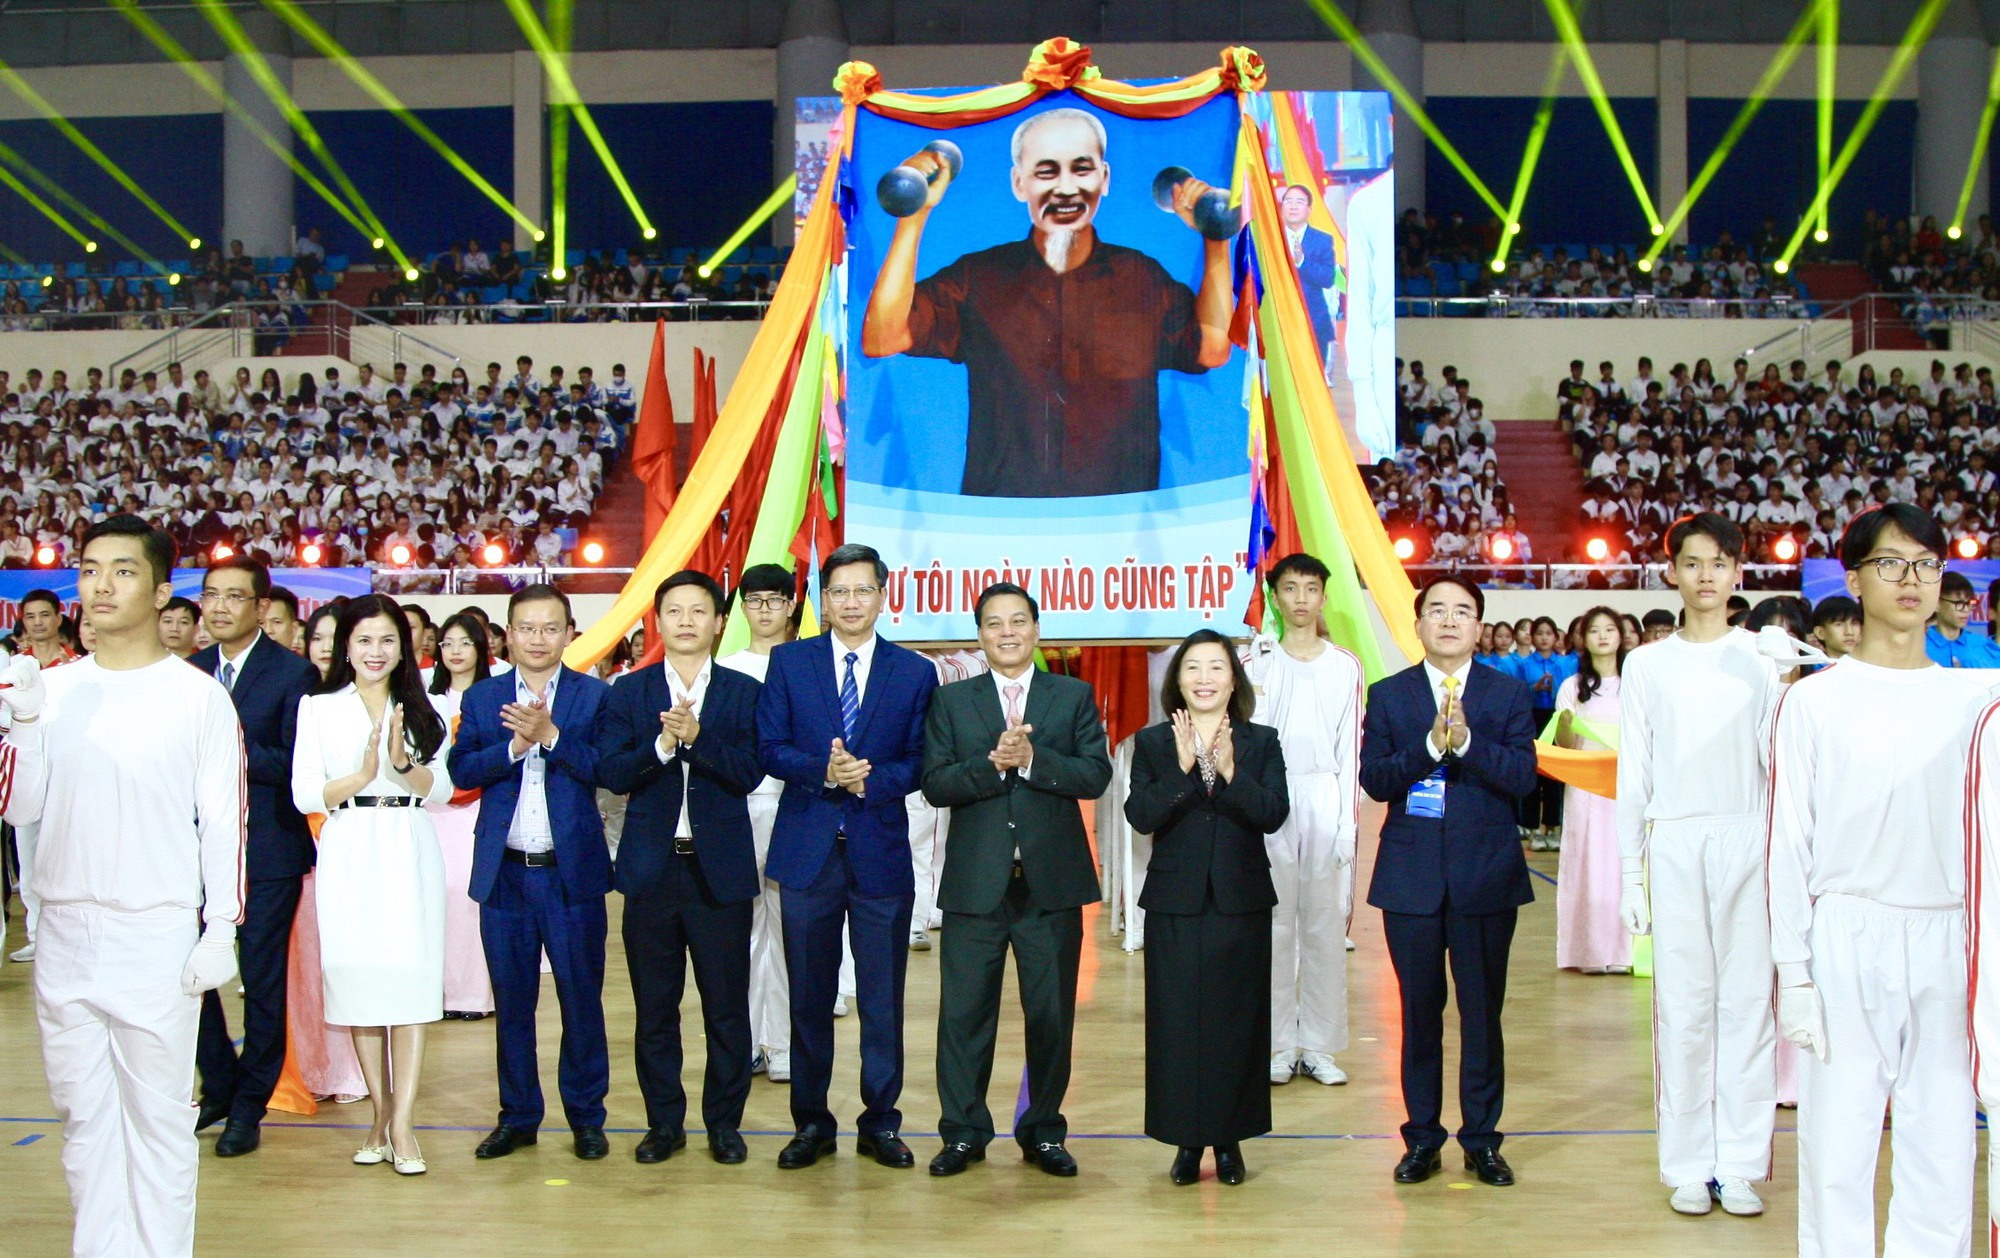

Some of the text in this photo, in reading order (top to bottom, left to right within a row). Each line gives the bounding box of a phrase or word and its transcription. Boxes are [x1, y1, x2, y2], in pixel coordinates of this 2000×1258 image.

[880, 566, 908, 624] Ự
[913, 560, 953, 613] TÔI
[1040, 558, 1095, 611] NÀO
[1103, 557, 1176, 610] CŨNG
